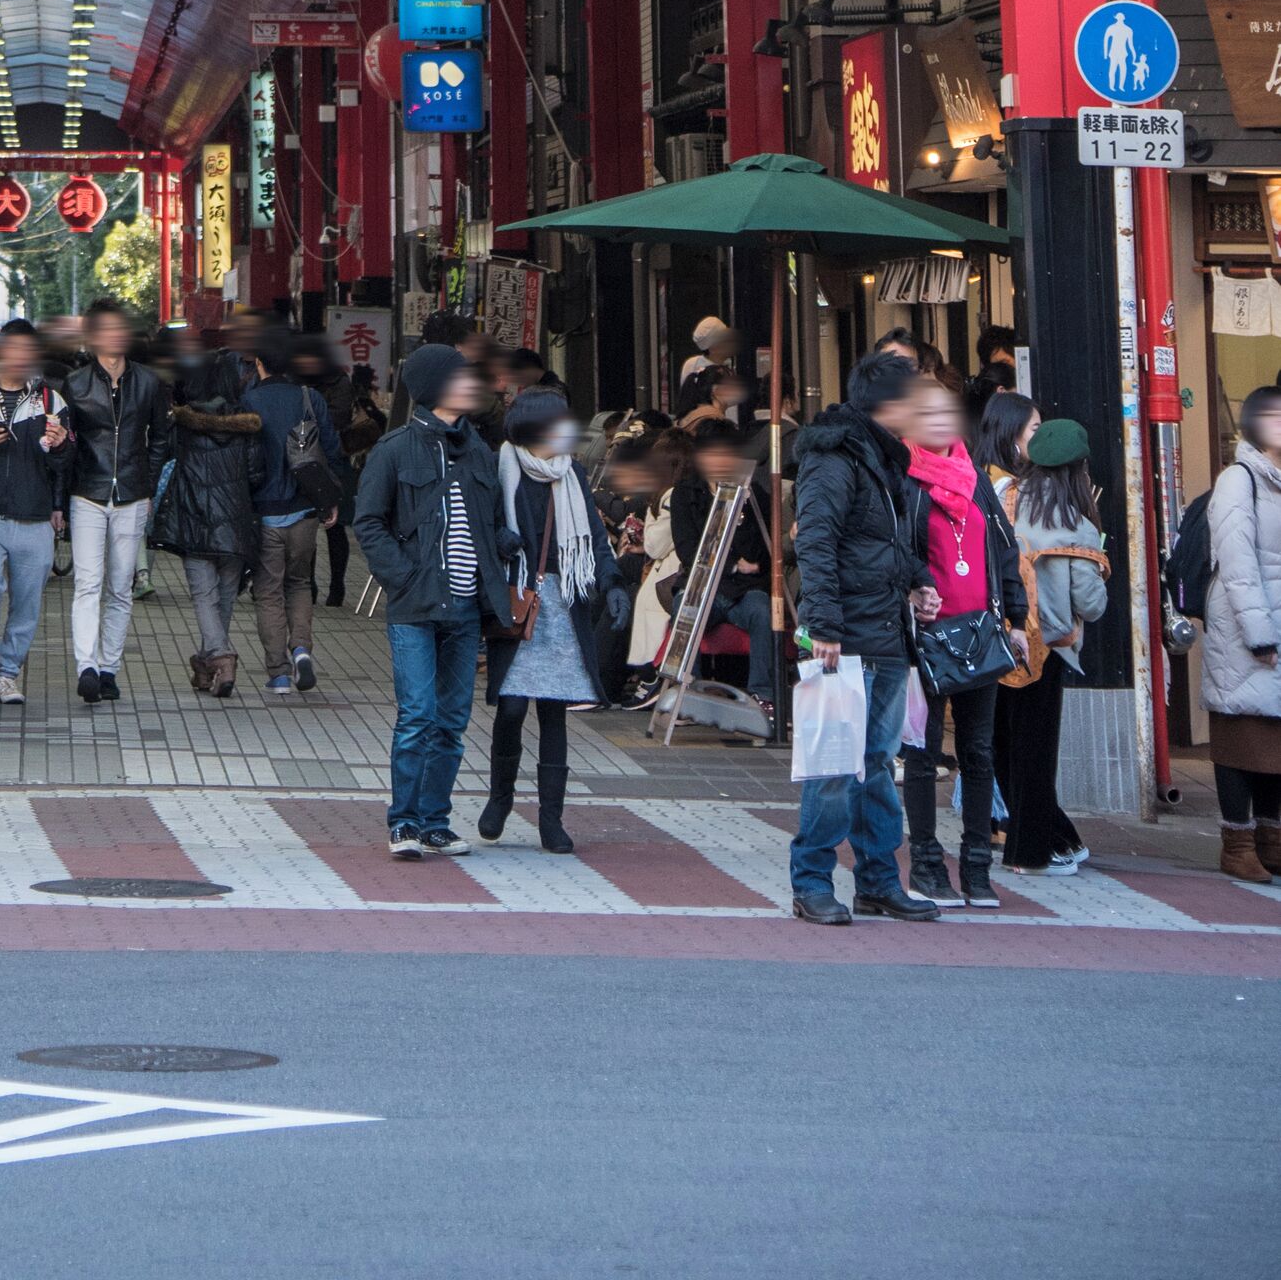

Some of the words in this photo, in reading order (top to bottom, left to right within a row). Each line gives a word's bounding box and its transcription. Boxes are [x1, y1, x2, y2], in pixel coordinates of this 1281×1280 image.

[1083, 113, 1179, 136] 軽車両を除く
[1091, 139, 1172, 162] 11-22
[62, 188, 95, 218] 須
